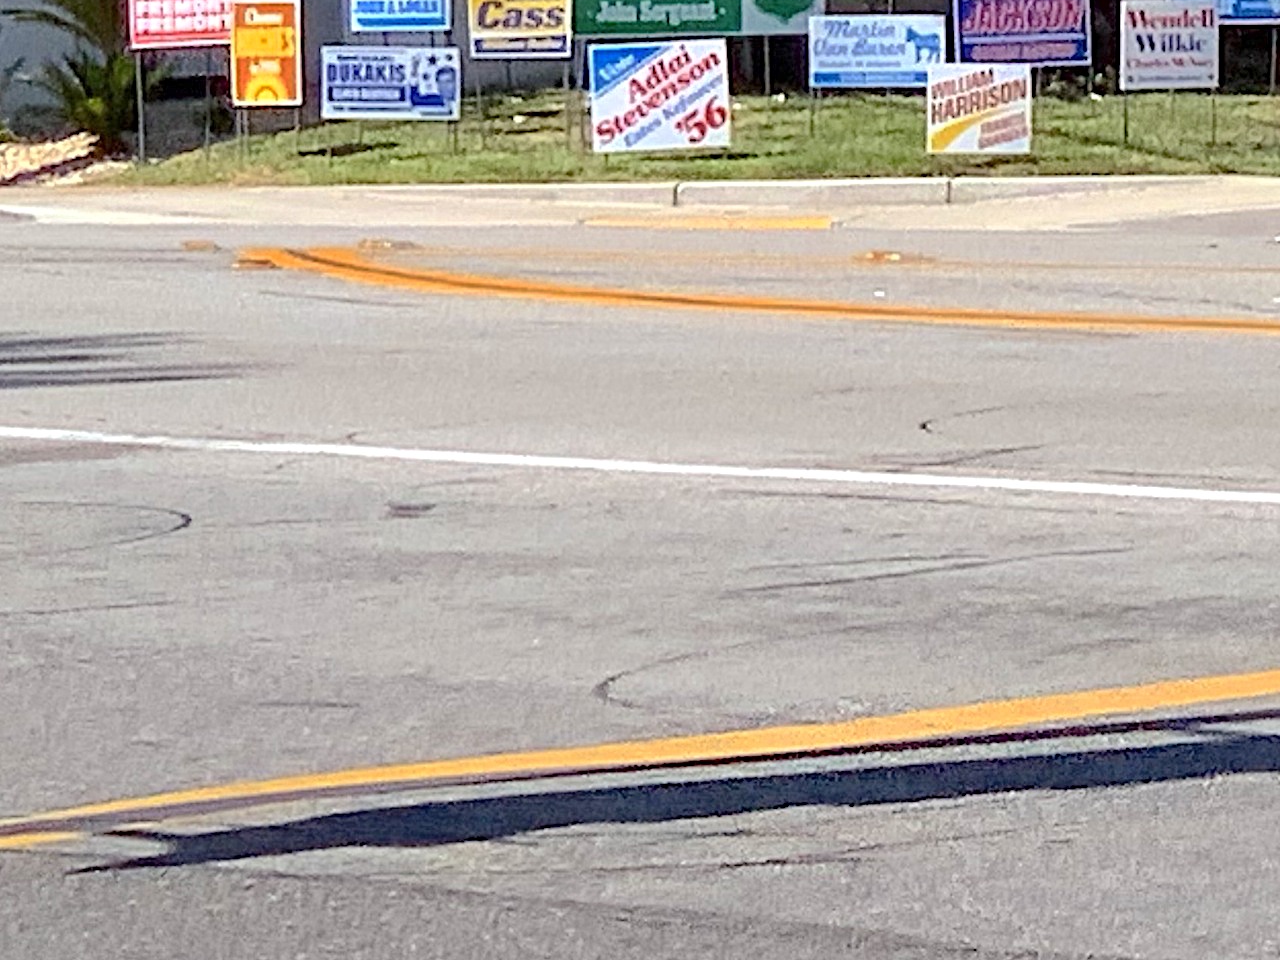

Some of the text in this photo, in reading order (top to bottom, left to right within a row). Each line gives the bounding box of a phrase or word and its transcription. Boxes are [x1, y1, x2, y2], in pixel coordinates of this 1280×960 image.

[477, 1, 565, 29] Cass
[326, 62, 406, 83] DUKAKIS
[628, 44, 693, 104] Adlai
[596, 52, 721, 145] Stevenson
[674, 95, 728, 144] '56
[930, 77, 1027, 126] HARRISON
